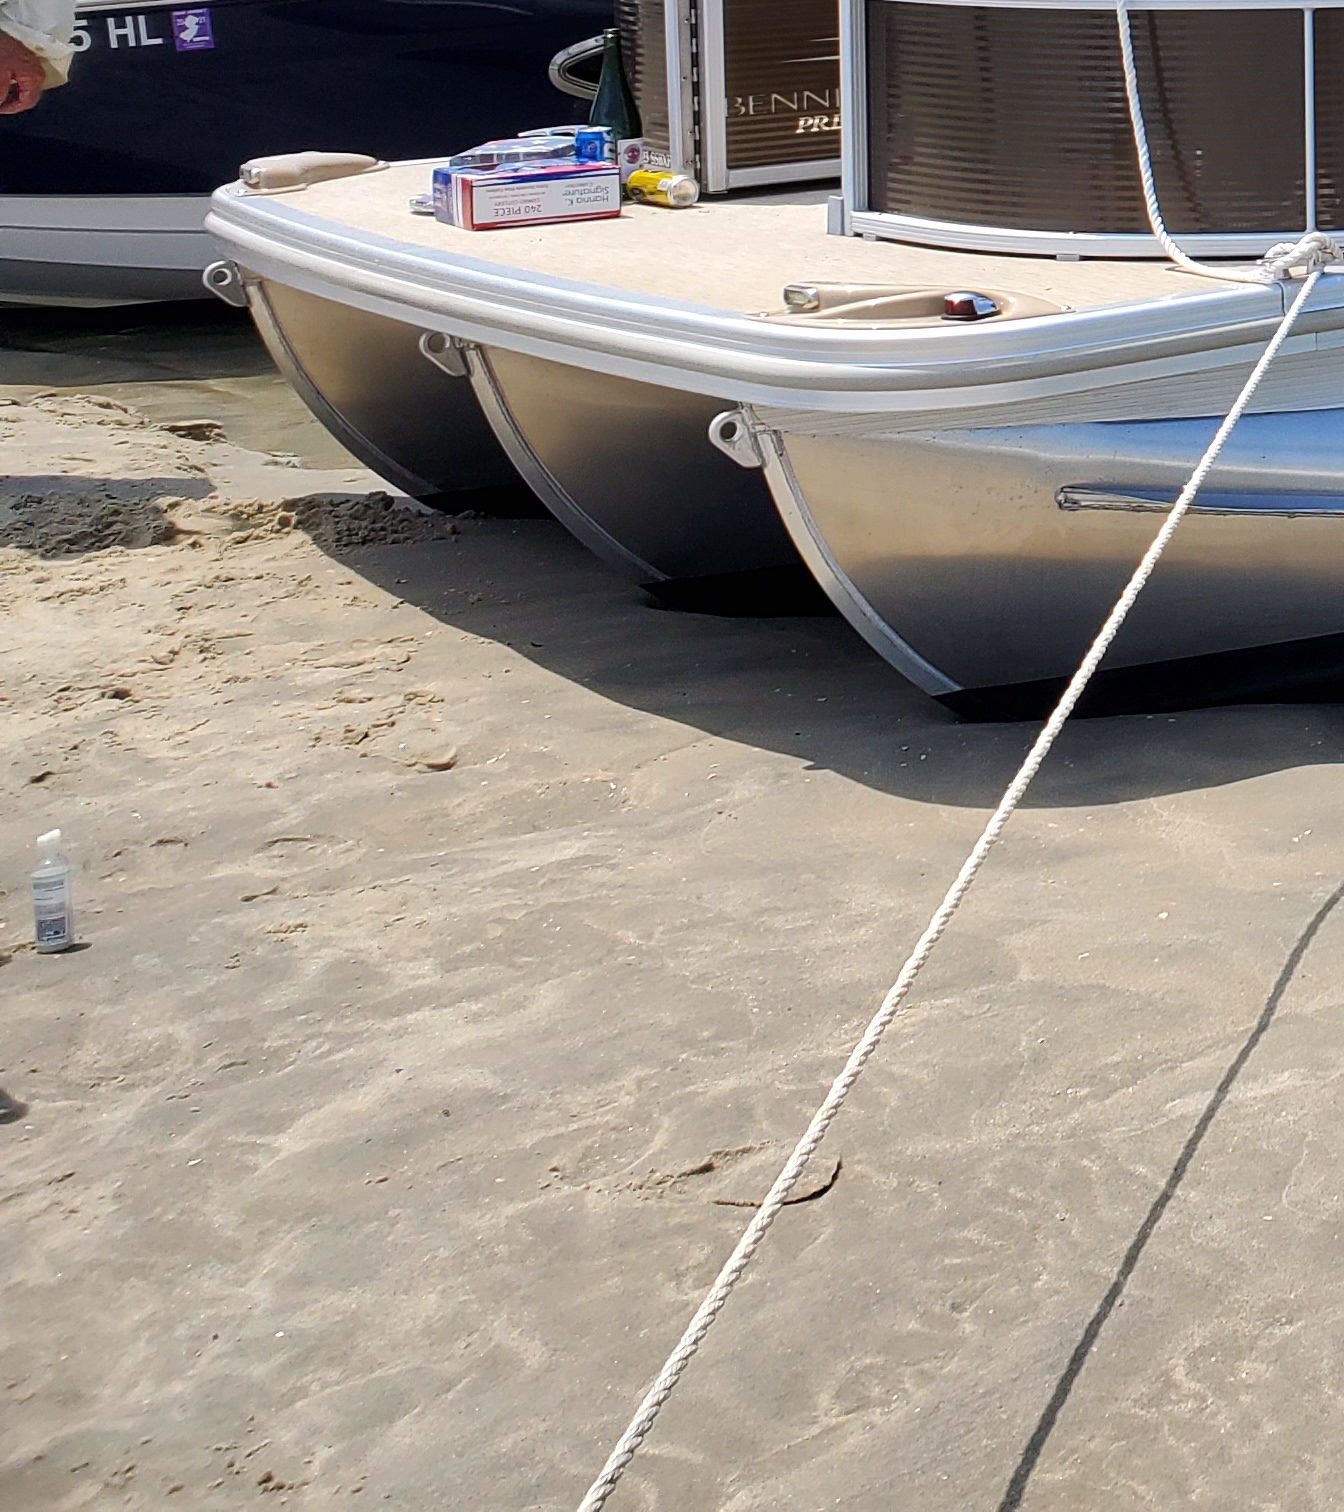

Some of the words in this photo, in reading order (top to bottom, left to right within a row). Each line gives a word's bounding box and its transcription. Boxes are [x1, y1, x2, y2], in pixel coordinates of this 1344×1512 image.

[106, 14, 164, 49] HL
[562, 184, 610, 197] Signature
[576, 194, 609, 204] Hanna
[493, 206, 521, 217] PIECE
[524, 204, 542, 214] 240
